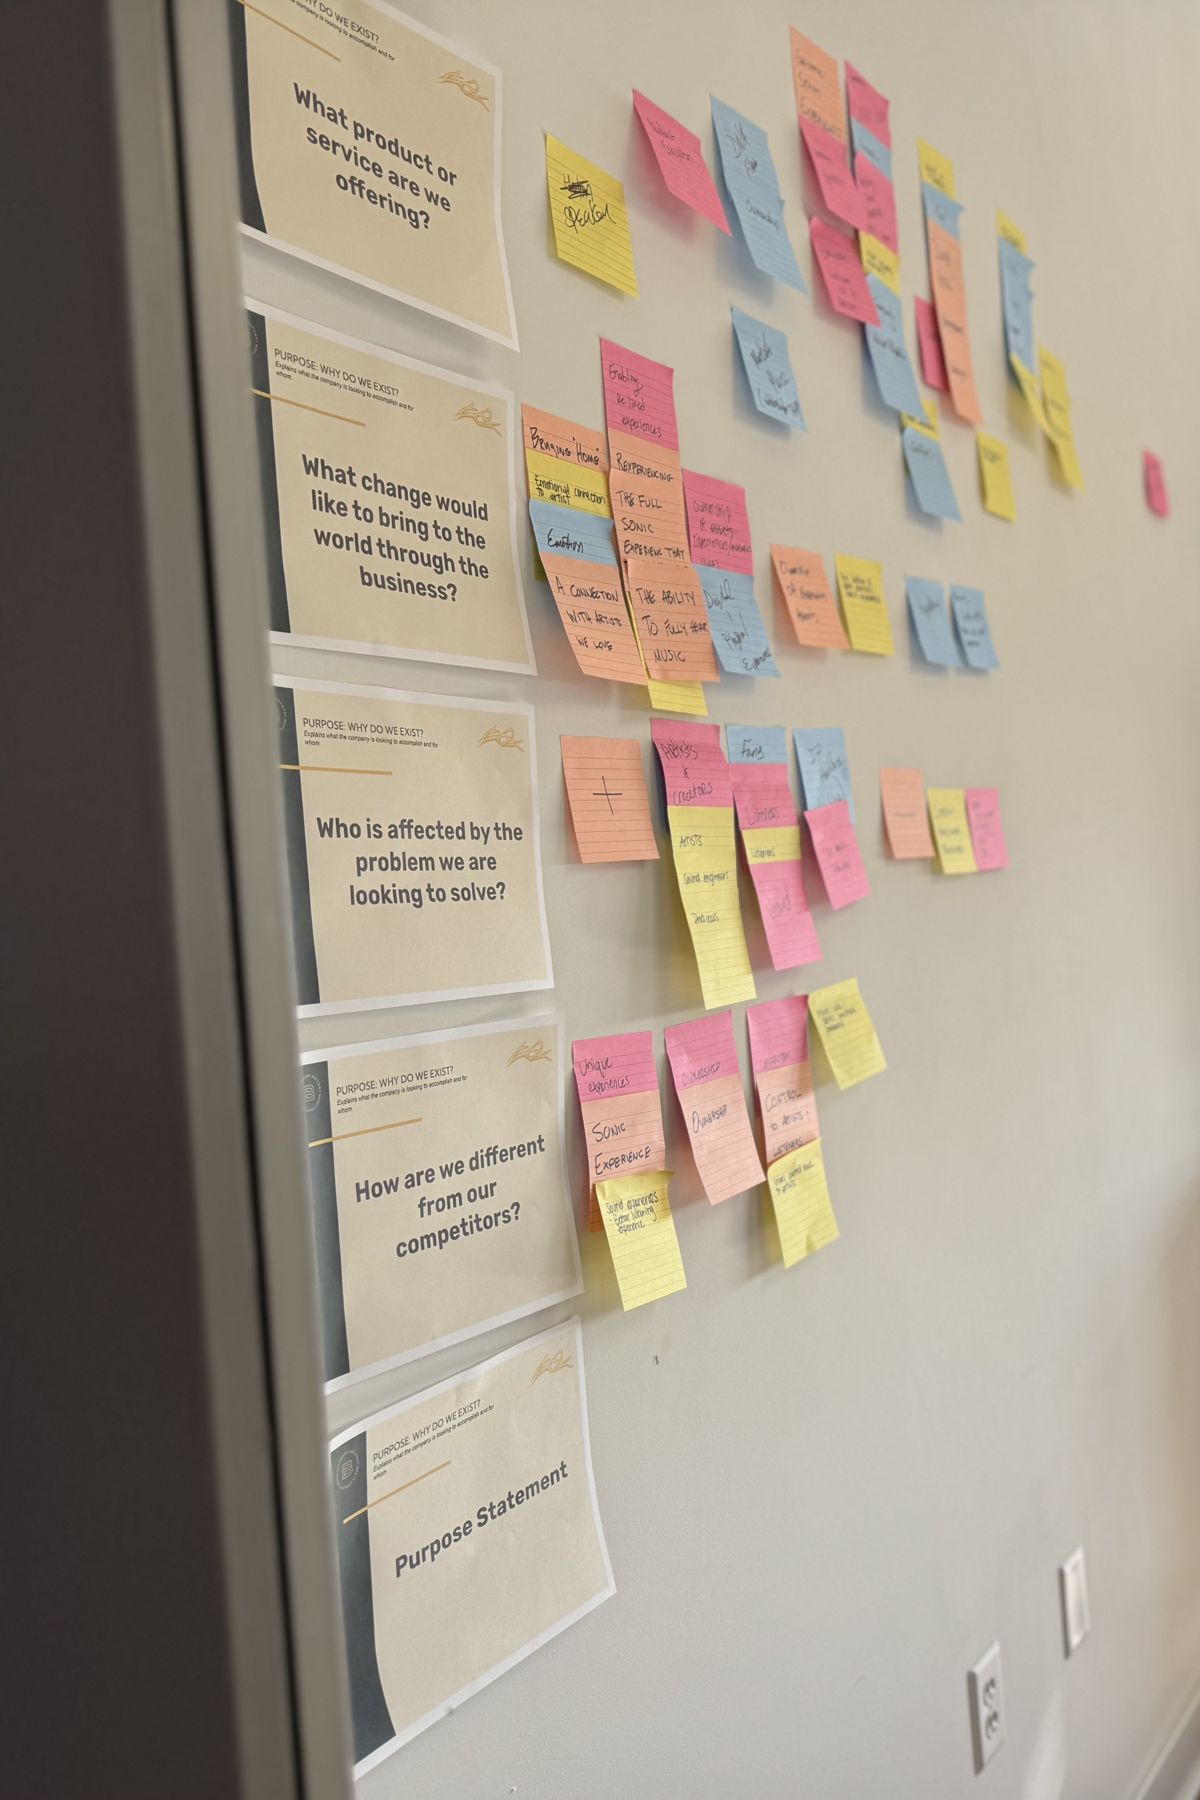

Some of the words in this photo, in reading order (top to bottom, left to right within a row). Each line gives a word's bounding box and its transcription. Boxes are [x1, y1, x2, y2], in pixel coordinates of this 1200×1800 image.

[320, 3, 332, 17] DO
[335, 12, 349, 28] WE
[351, 21, 380, 43] EXIST?
[294, 82, 349, 130] What
[353, 120, 433, 175] product
[438, 166, 457, 186] or
[306, 127, 383, 178] service
[388, 170, 420, 196] are
[424, 187, 451, 212] we
[336, 174, 430, 229] offering?
[274, 348, 318, 371] PURPOSE:
[320, 363, 340, 378] WHY
[342, 371, 356, 383] DO
[358, 376, 372, 389] WE
[373, 381, 399, 397] EXIST?
[320, 376, 342, 390] company
[348, 384, 366, 397] looking
[302, 454, 357, 487] What
[362, 473, 432, 509] change
[436, 494, 488, 522] would
[639, 495, 662, 508] FULL
[312, 489, 348, 517] like
[352, 500, 374, 523] to
[378, 506, 429, 541] bring
[432, 520, 452, 542] to
[456, 526, 486, 550] the
[621, 517, 654, 533] SONIC
[314, 528, 373, 555] world
[376, 537, 456, 575] through
[458, 556, 489, 579] the
[664, 548, 684, 560] THAT
[360, 565, 457, 602] business?
[570, 584, 619, 602] CONNECTION
[636, 588, 656, 604] THE
[662, 589, 696, 606] ABILITY
[567, 610, 592, 625] WITH
[664, 619, 688, 636] FULLY
[576, 636, 588, 648] WE
[654, 648, 686, 662] MUSIC
[303, 718, 345, 731] PURPOSE:
[347, 722, 368, 733] WHY
[370, 725, 384, 734] DO
[386, 726, 398, 736] WE
[400, 727, 424, 738] EXIST?
[348, 735, 370, 743] company
[376, 737, 393, 745] looking
[316, 817, 362, 839] Who
[366, 818, 383, 839] is
[388, 819, 466, 840] affected
[470, 821, 490, 845] by
[494, 822, 523, 841] the
[356, 851, 435, 877] problem
[439, 856, 464, 871] we
[469, 856, 497, 870] are
[350, 884, 423, 909] looking
[426, 883, 446, 903] to
[451, 882, 506, 901] solve?
[336, 1080, 377, 1096] PURPOSE:
[379, 1076, 399, 1088] WHY
[400, 1073, 414, 1084] DO
[415, 1071, 429, 1081] WE
[430, 1066, 454, 1079] EXIST?
[379, 1088, 400, 1098] company
[406, 1084, 423, 1093] looking
[592, 1122, 626, 1143] SONIC
[355, 1176, 399, 1202] How
[404, 1168, 435, 1189] are
[439, 1160, 465, 1179] we
[469, 1135, 545, 1172] different
[594, 1146, 651, 1176] EXPERIENCE
[418, 1192, 463, 1218] from
[467, 1181, 497, 1203] our
[396, 1201, 521, 1258] competitors?
[412, 1425, 431, 1441] WHY
[432, 1418, 444, 1431] DO
[445, 1411, 457, 1424] WE
[458, 1399, 481, 1418] EXIST?
[395, 1520, 473, 1578] Purpose
[476, 1461, 568, 1528] Statement
